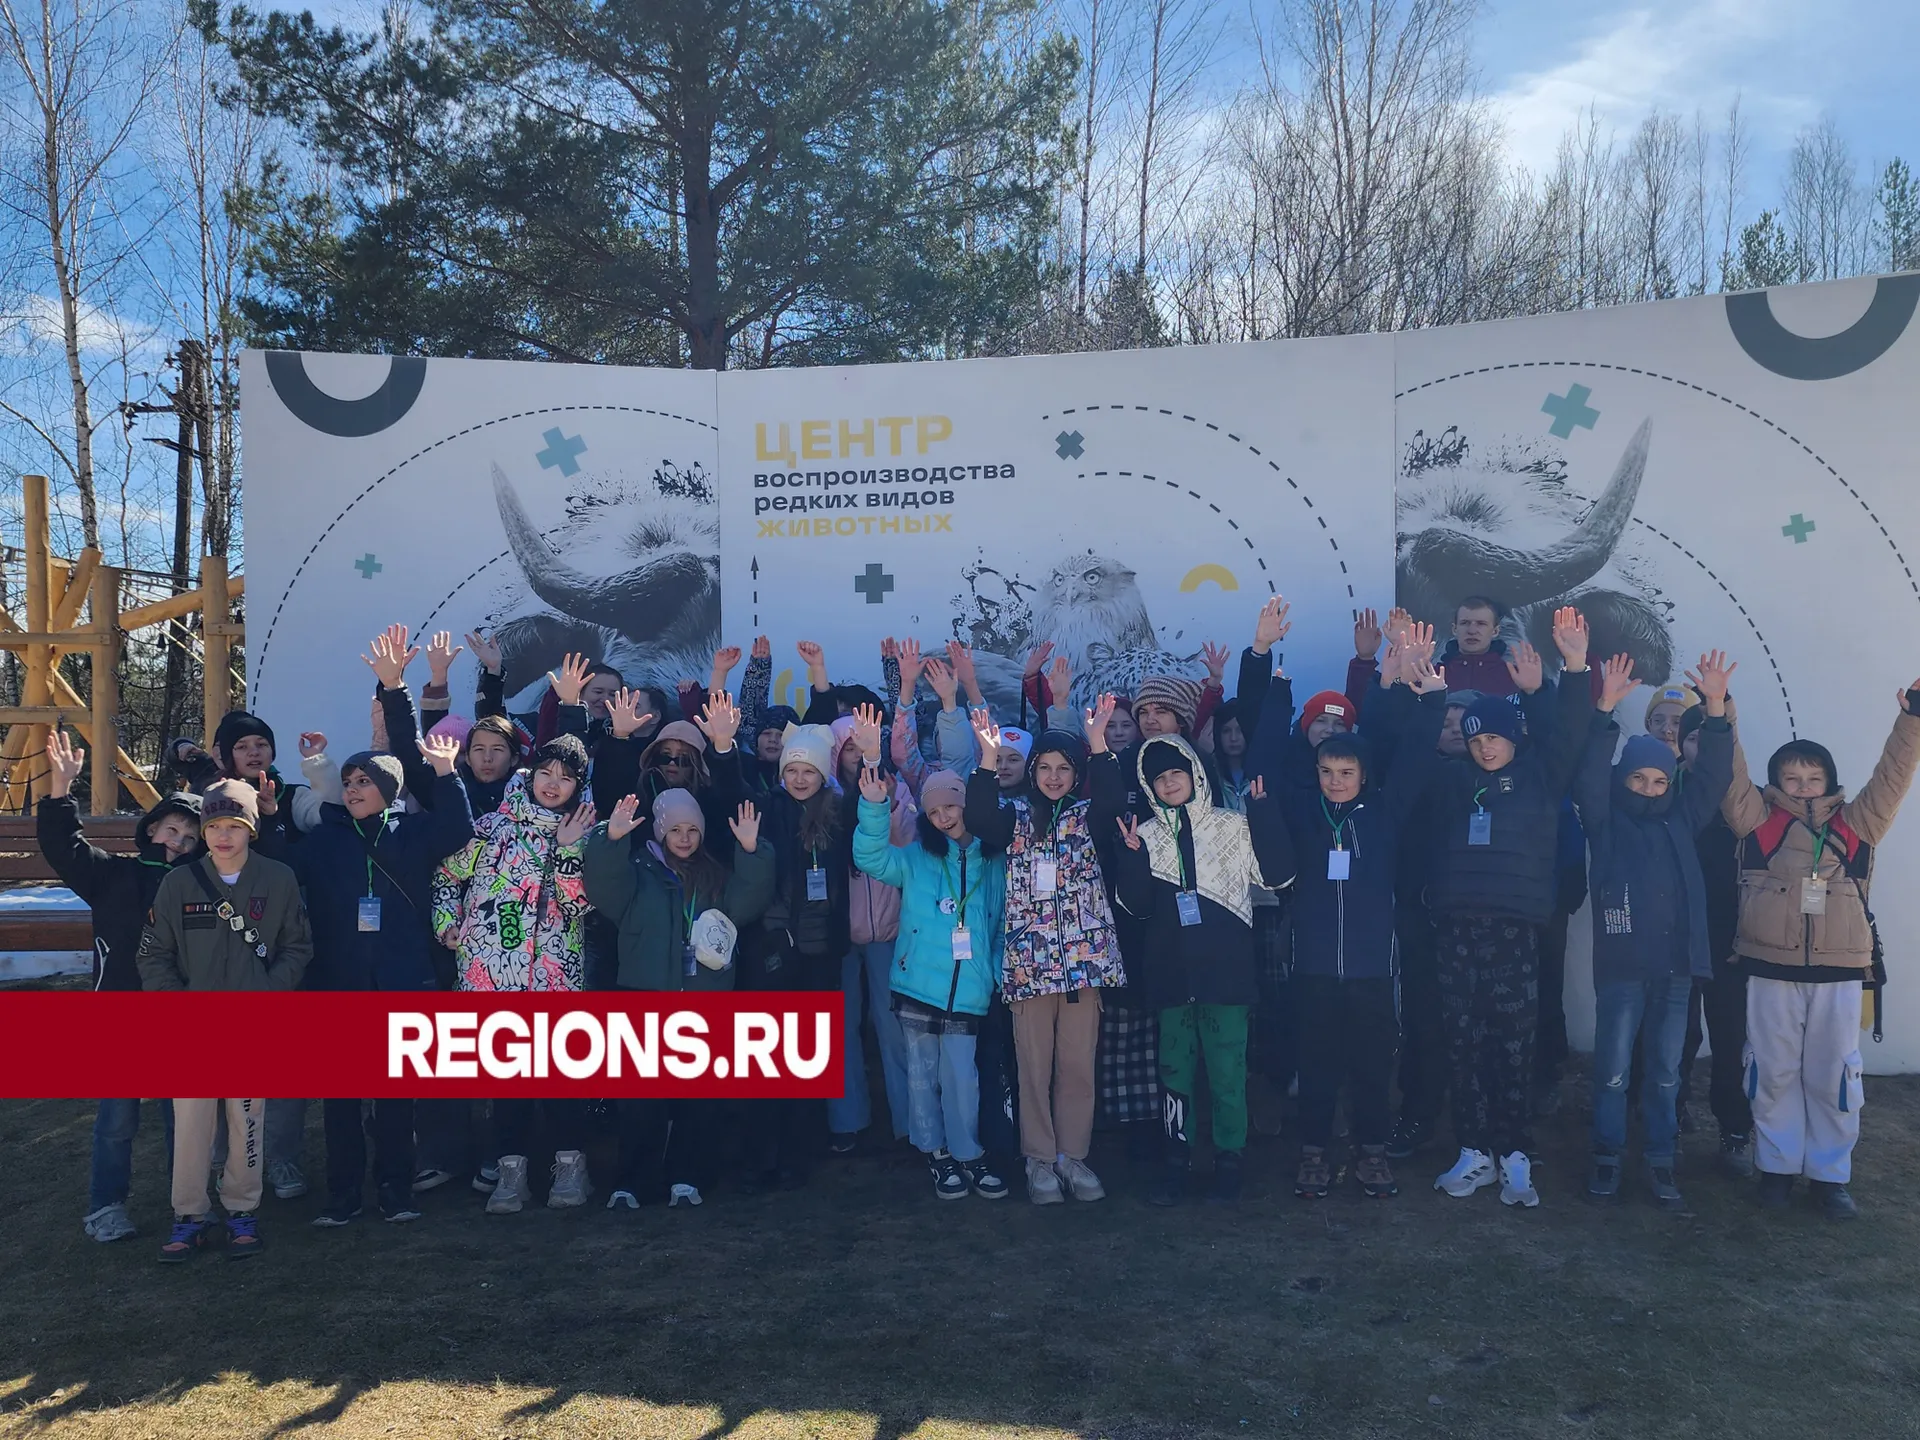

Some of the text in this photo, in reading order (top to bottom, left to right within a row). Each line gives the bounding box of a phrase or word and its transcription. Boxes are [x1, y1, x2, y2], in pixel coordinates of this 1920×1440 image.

[755, 415, 953, 469] ЦЕНТР
[754, 463, 1016, 491] воспроизводства
[755, 489, 955, 516] редких видов
